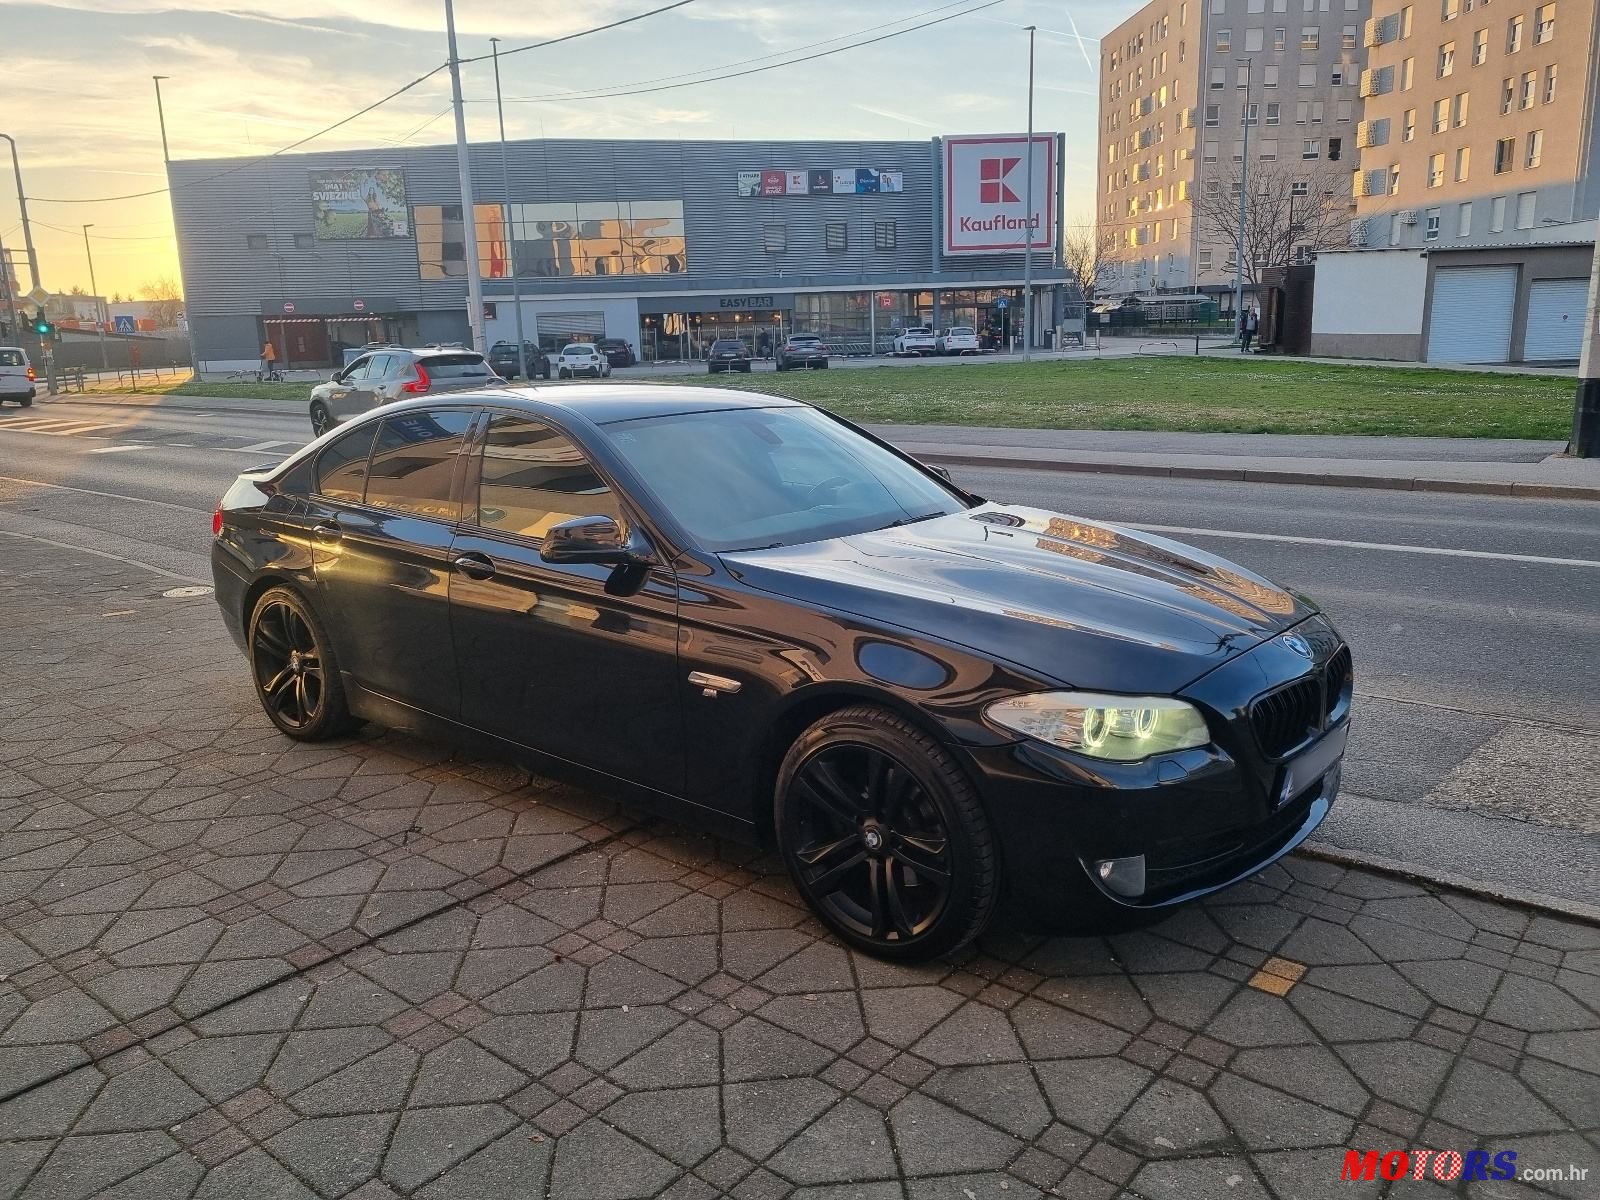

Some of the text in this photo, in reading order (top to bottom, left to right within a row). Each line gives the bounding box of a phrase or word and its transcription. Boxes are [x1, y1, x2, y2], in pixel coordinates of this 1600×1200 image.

[980, 157, 1022, 203] K
[960, 213, 1040, 232] Kaufland
[719, 297, 772, 308] EASY BAR
